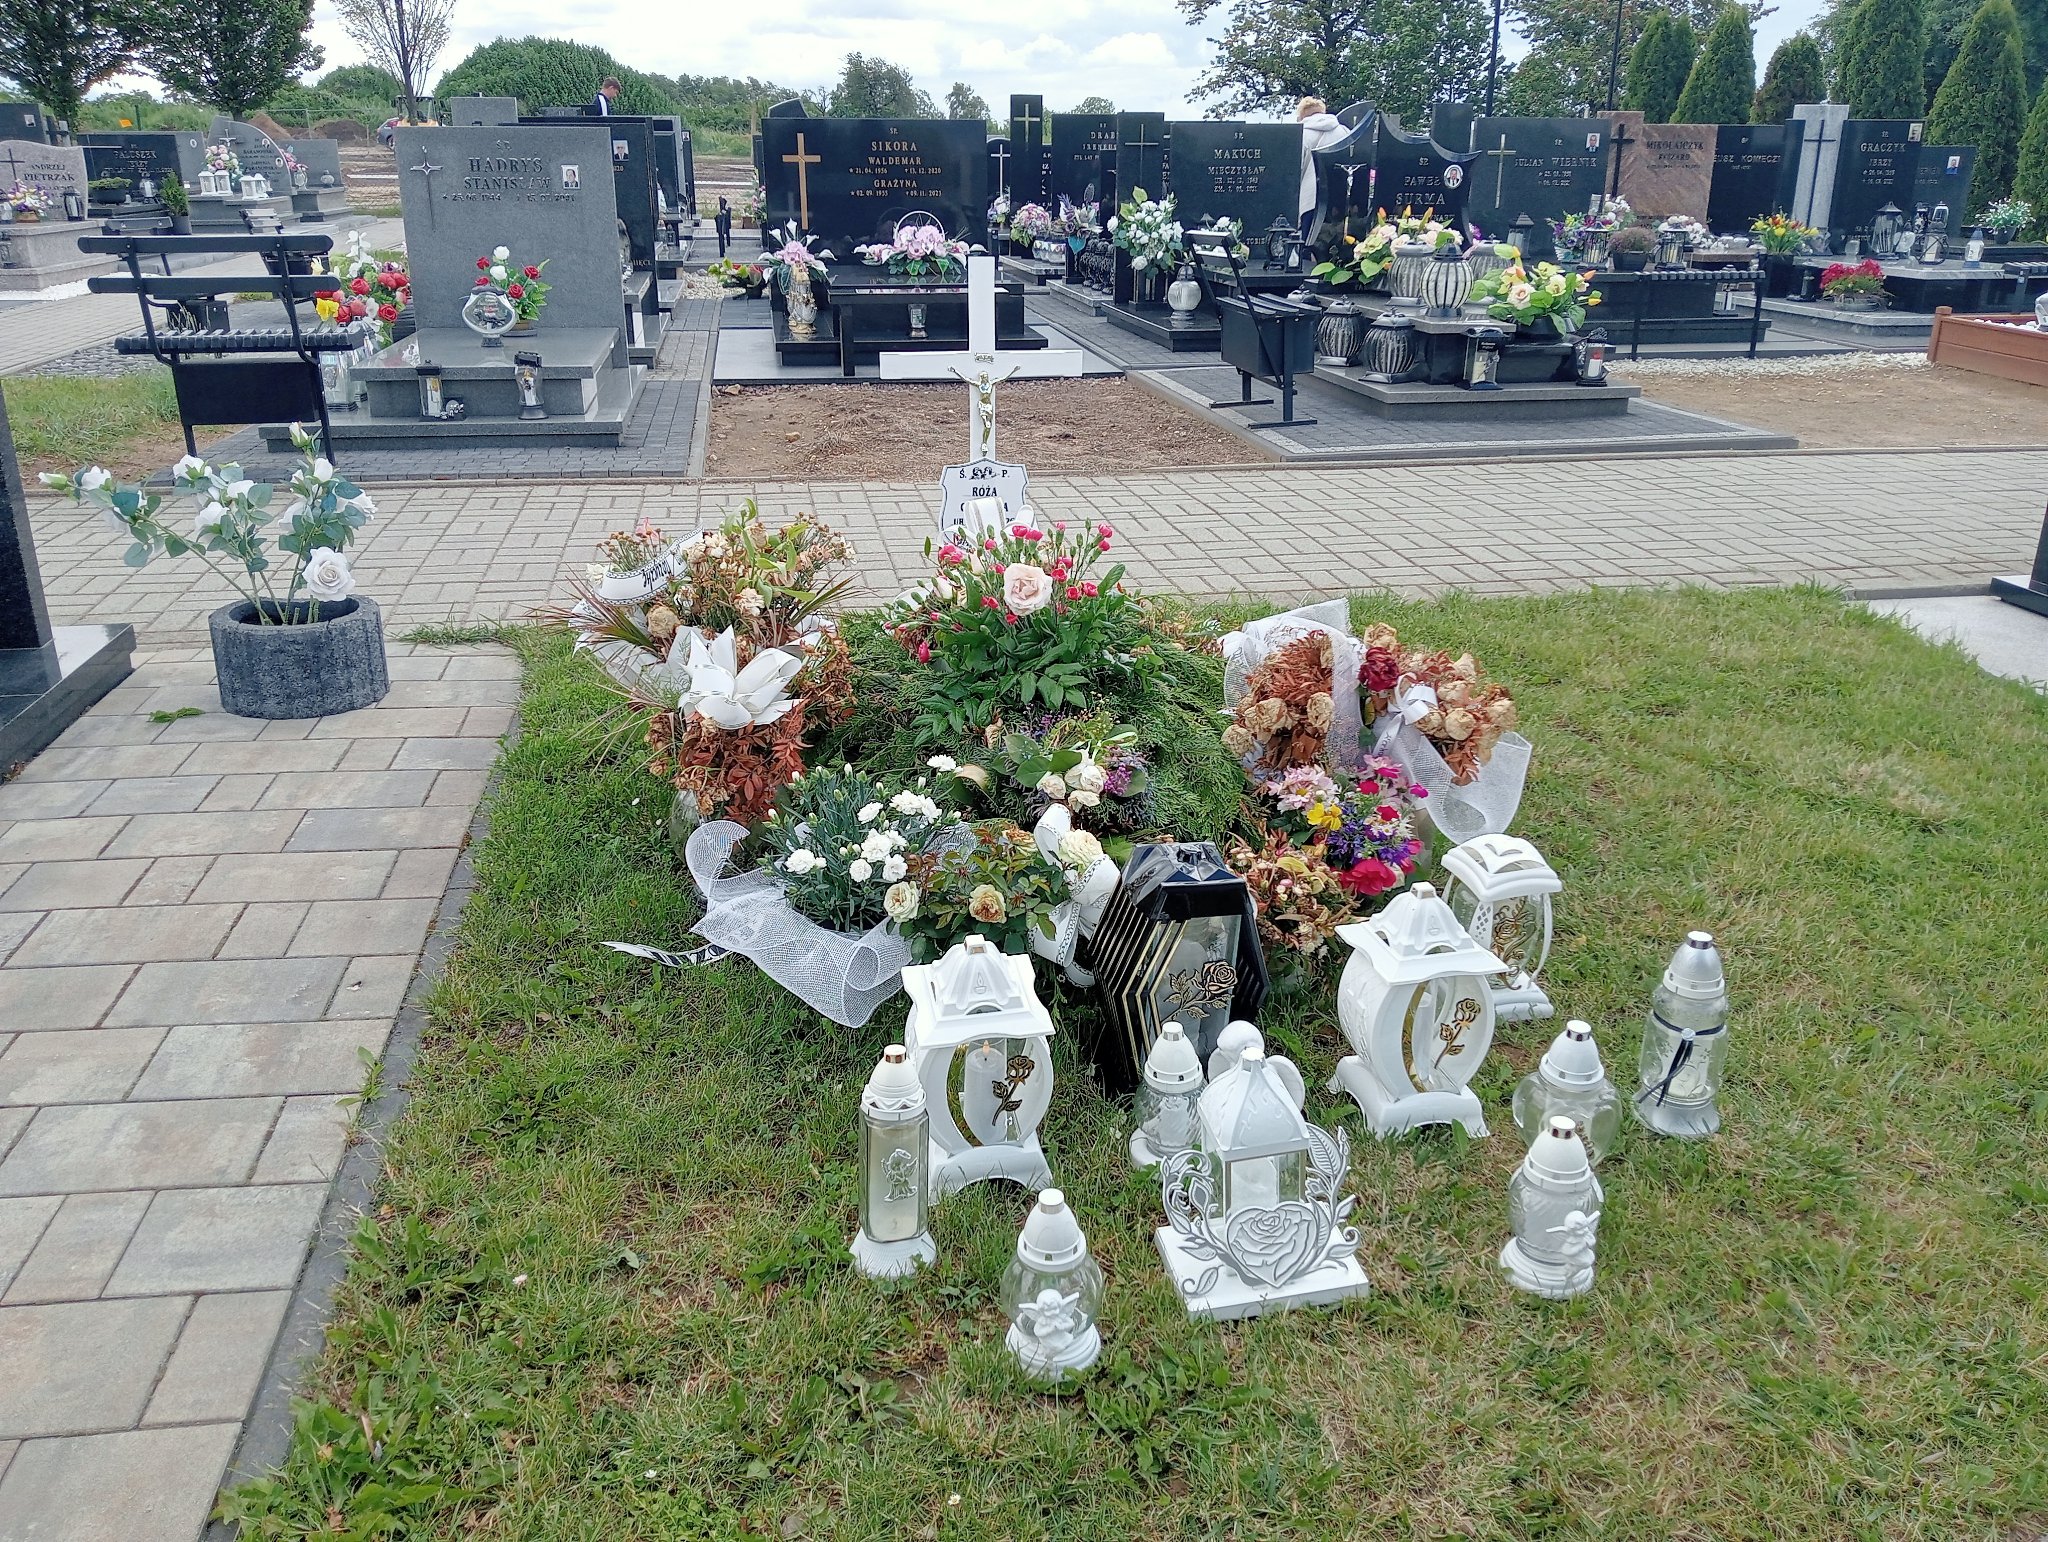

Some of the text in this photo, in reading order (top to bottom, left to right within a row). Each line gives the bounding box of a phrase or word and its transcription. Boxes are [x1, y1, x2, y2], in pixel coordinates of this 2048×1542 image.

[871, 141, 918, 152] SIKORA
[1860, 142, 1906, 152] GRACZYK
[1213, 148, 1261, 159] MAKUCH
[868, 156, 921, 165] WALDEMAR
[1513, 158, 1544, 167] JULIAN
[1207, 165, 1266, 175] MIECZYSŁAW
[23, 173, 75, 181] PIETRZAK
[873, 178, 918, 188] GRAŻYNA
[1395, 193, 1446, 205] SURMA
[959, 467, 1011, 479] Ś. P.
[971, 484, 998, 497] RÓŻA
